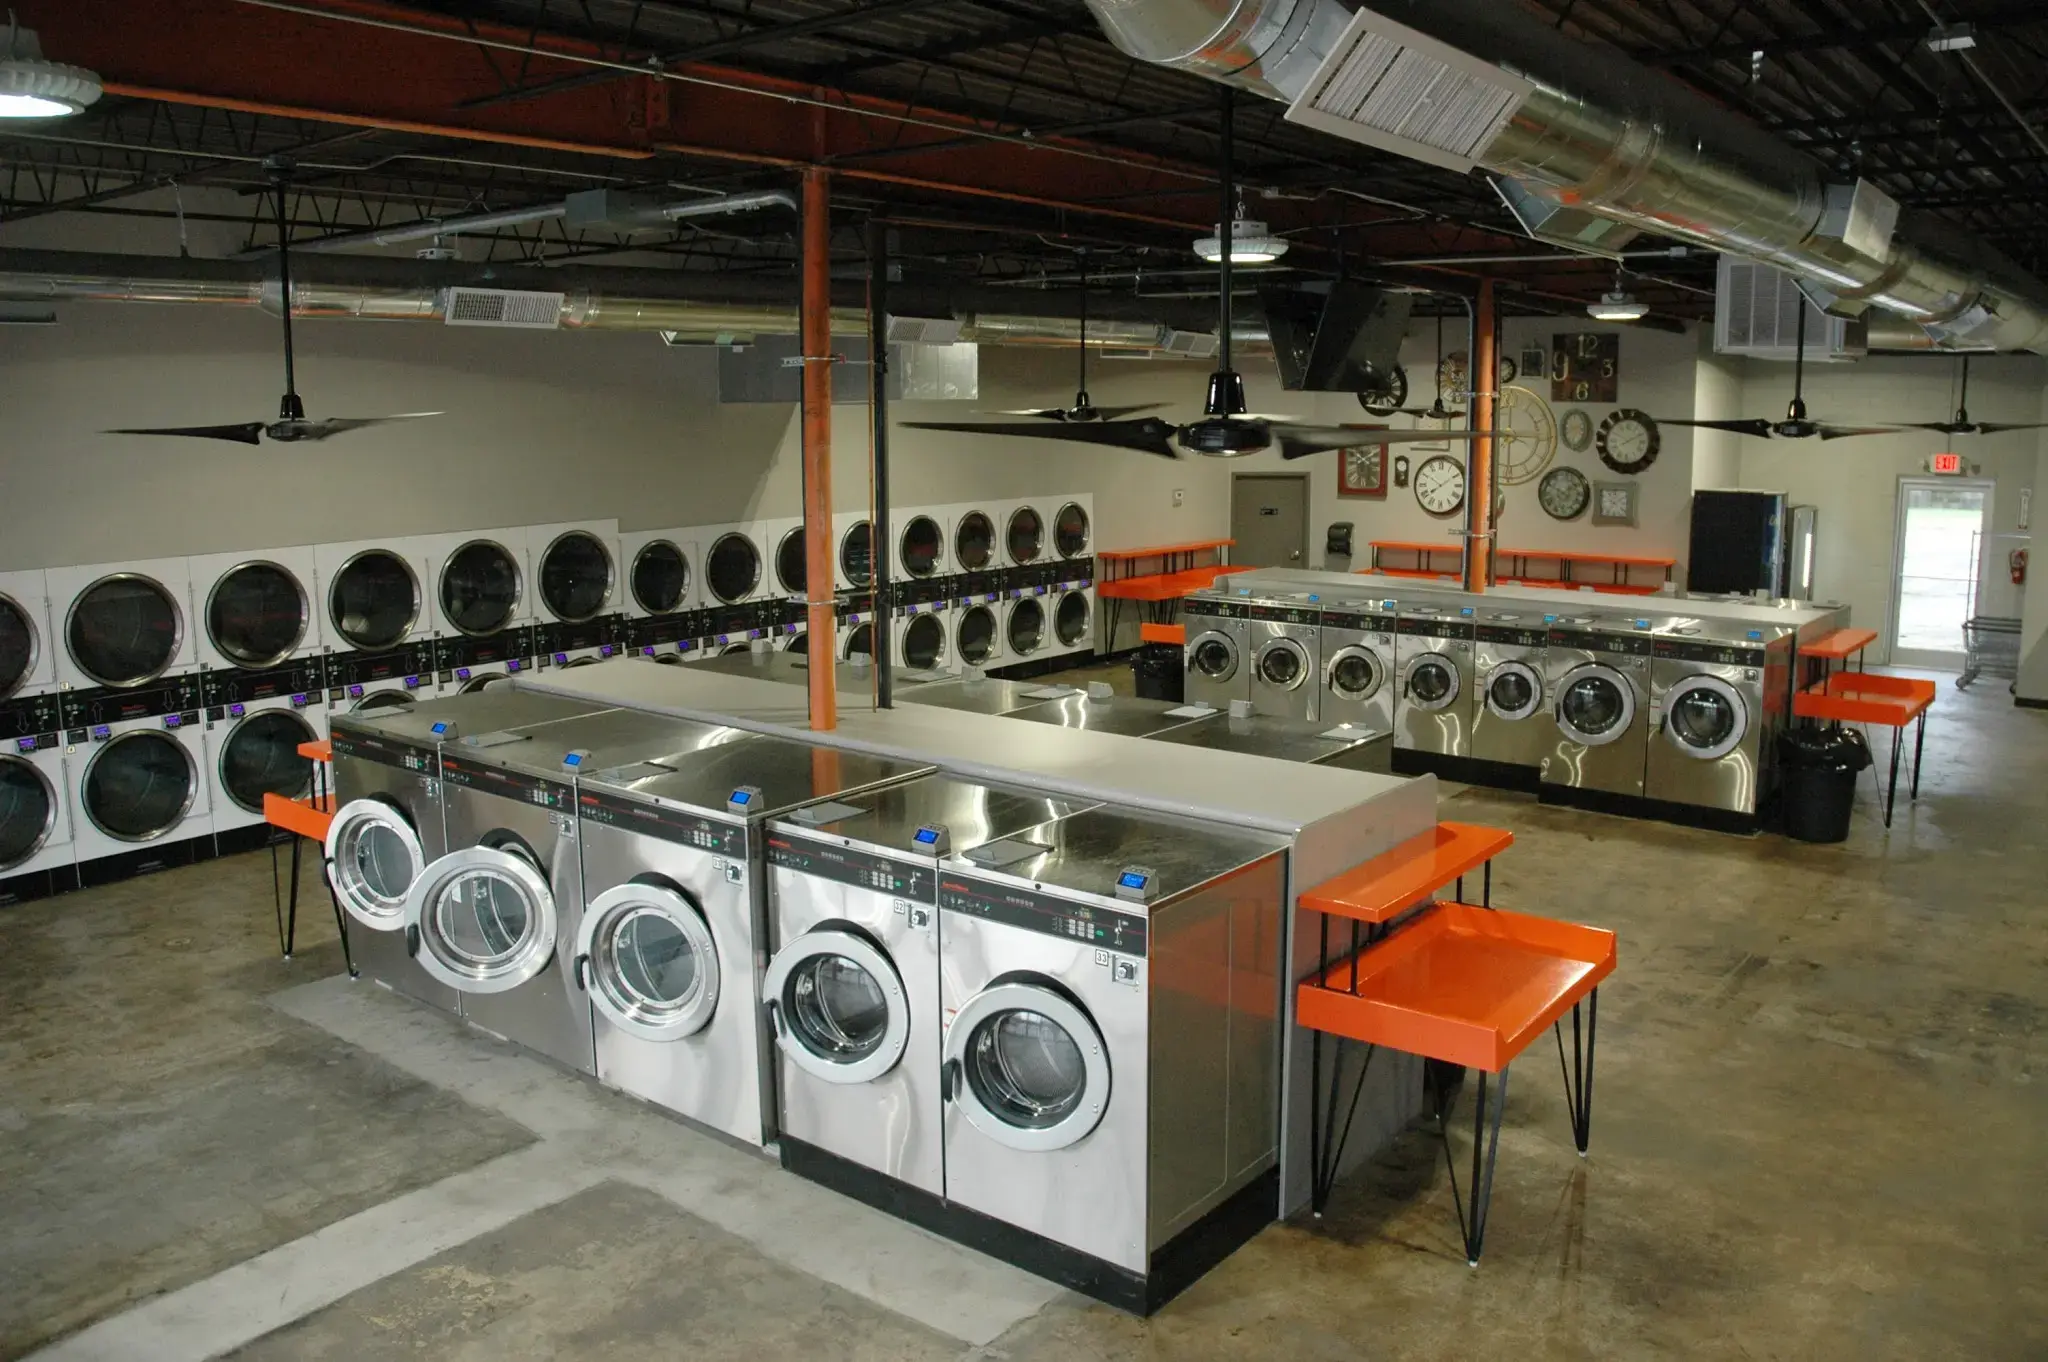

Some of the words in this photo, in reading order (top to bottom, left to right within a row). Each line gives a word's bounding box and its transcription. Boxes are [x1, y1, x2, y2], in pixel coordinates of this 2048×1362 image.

[1578, 335, 1598, 358] 12
[1552, 351, 1569, 381] 9
[1602, 358, 1613, 378] 3
[1576, 381, 1589, 400] 6
[1935, 455, 1957, 470] EXIT
